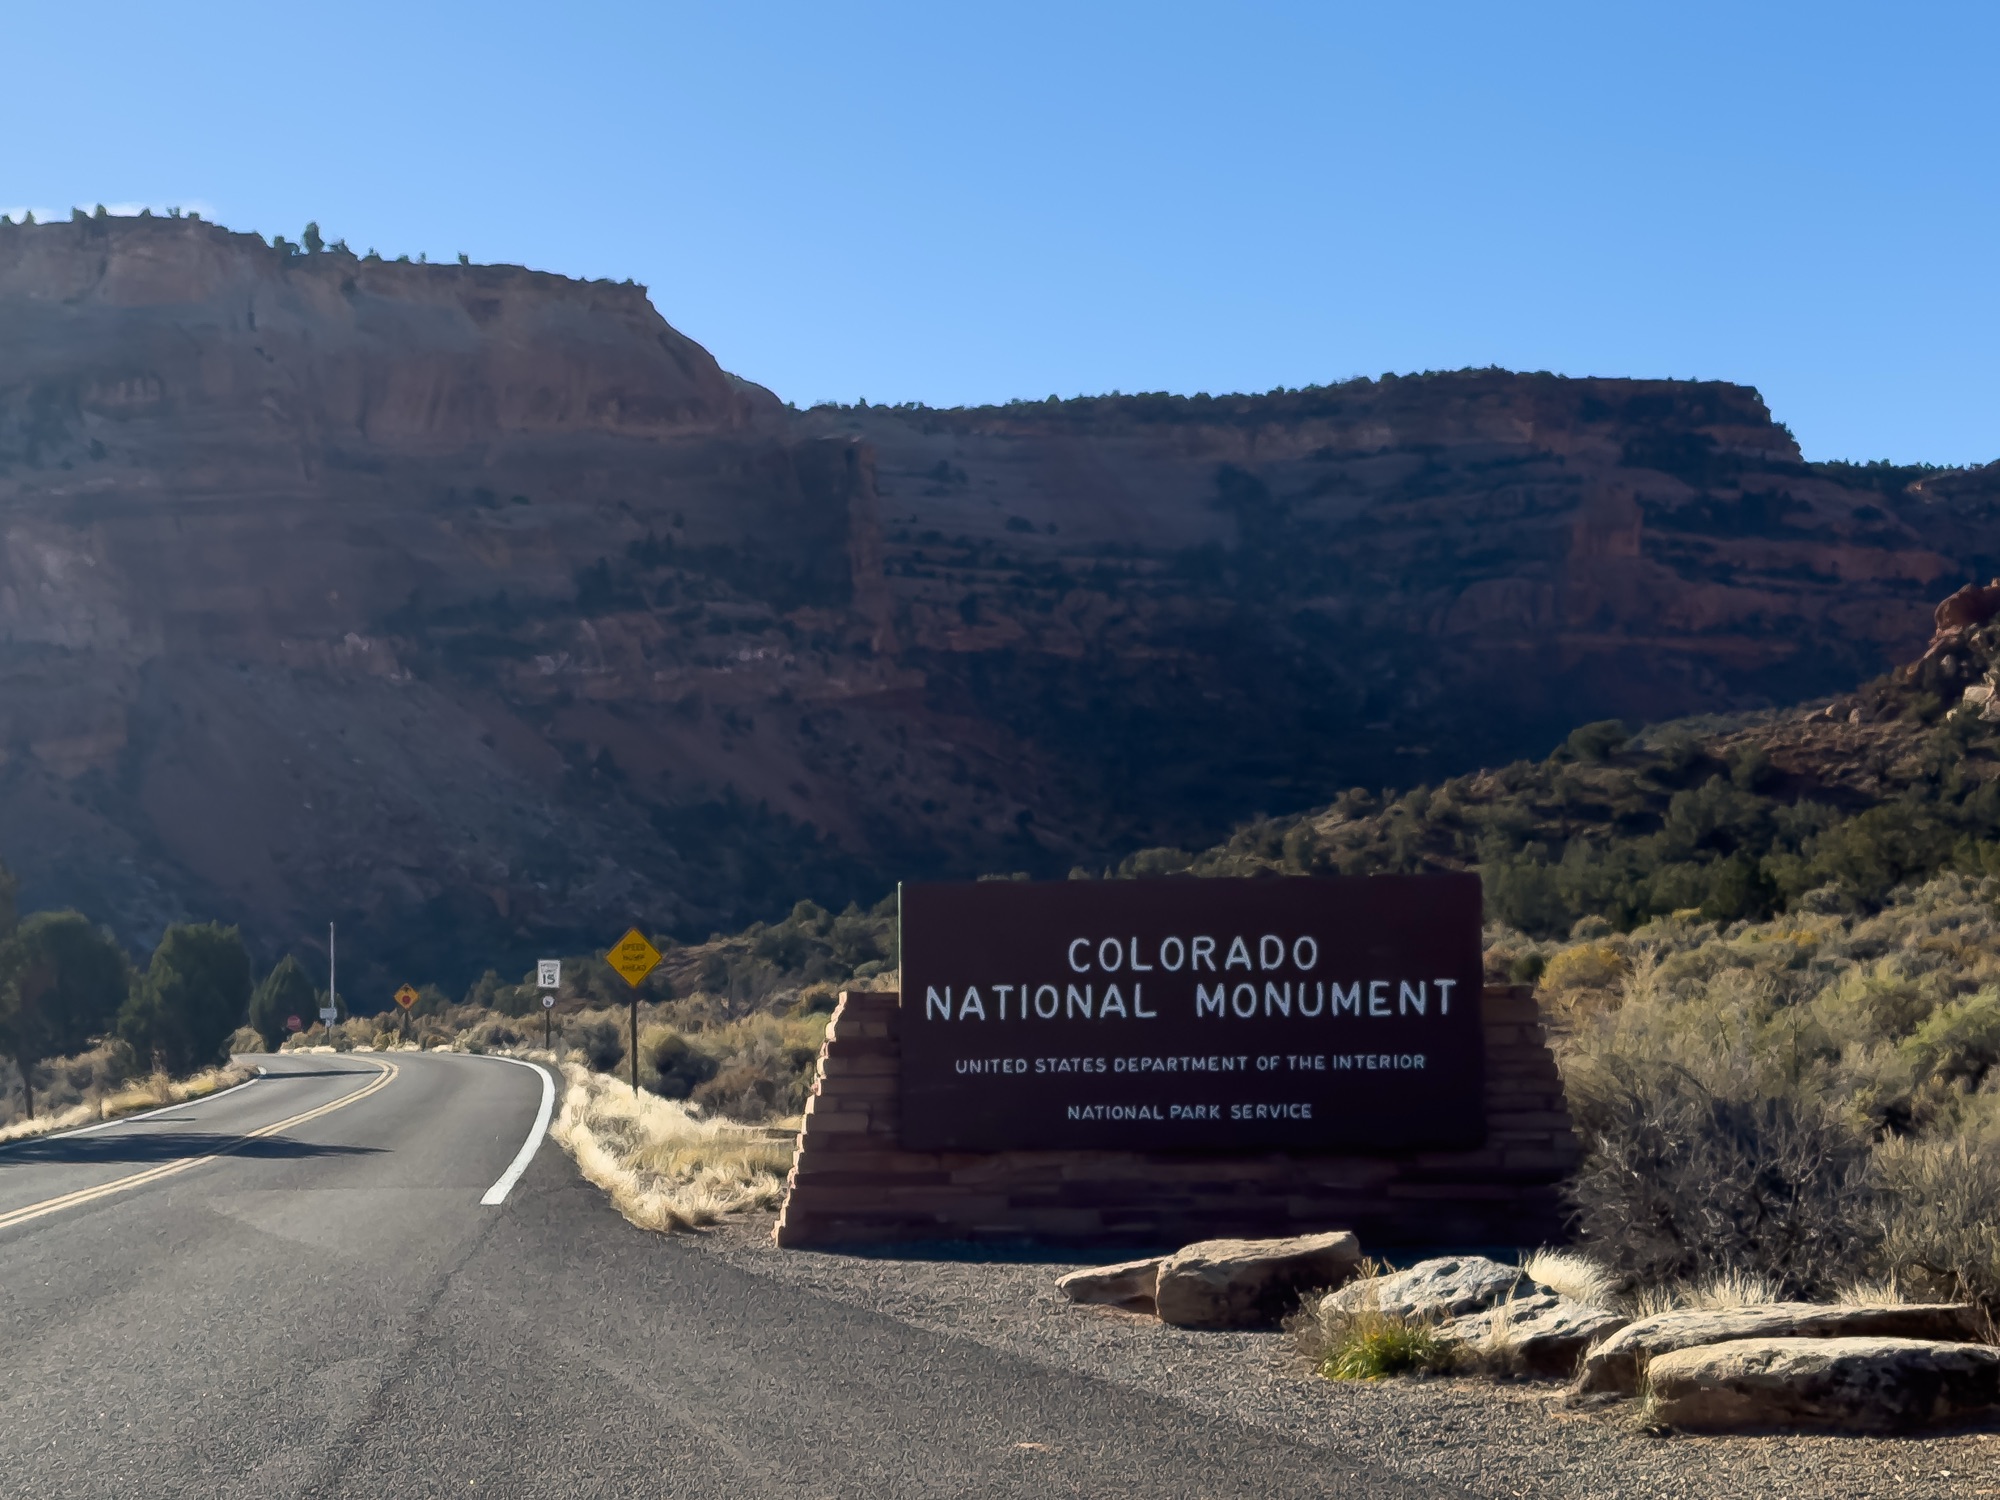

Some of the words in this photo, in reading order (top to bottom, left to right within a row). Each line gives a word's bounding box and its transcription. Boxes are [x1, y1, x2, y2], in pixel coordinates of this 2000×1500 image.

[1067, 935, 1319, 973] COLORADO
[542, 973, 556, 985] 15
[925, 982, 1158, 1021] NATIONAL
[1196, 978, 1458, 1018] MONUMENT
[955, 1058, 1028, 1074] UNITED
[1035, 1057, 1107, 1074] STATES
[1113, 1055, 1248, 1073] DEPARTMENT
[1256, 1055, 1280, 1071] OF
[1286, 1055, 1325, 1070] THE
[1333, 1054, 1426, 1070] INTERIOR
[1067, 1105, 1164, 1120] NATIONAL
[1170, 1104, 1220, 1119] PARK
[1230, 1103, 1312, 1120] SERVICE
